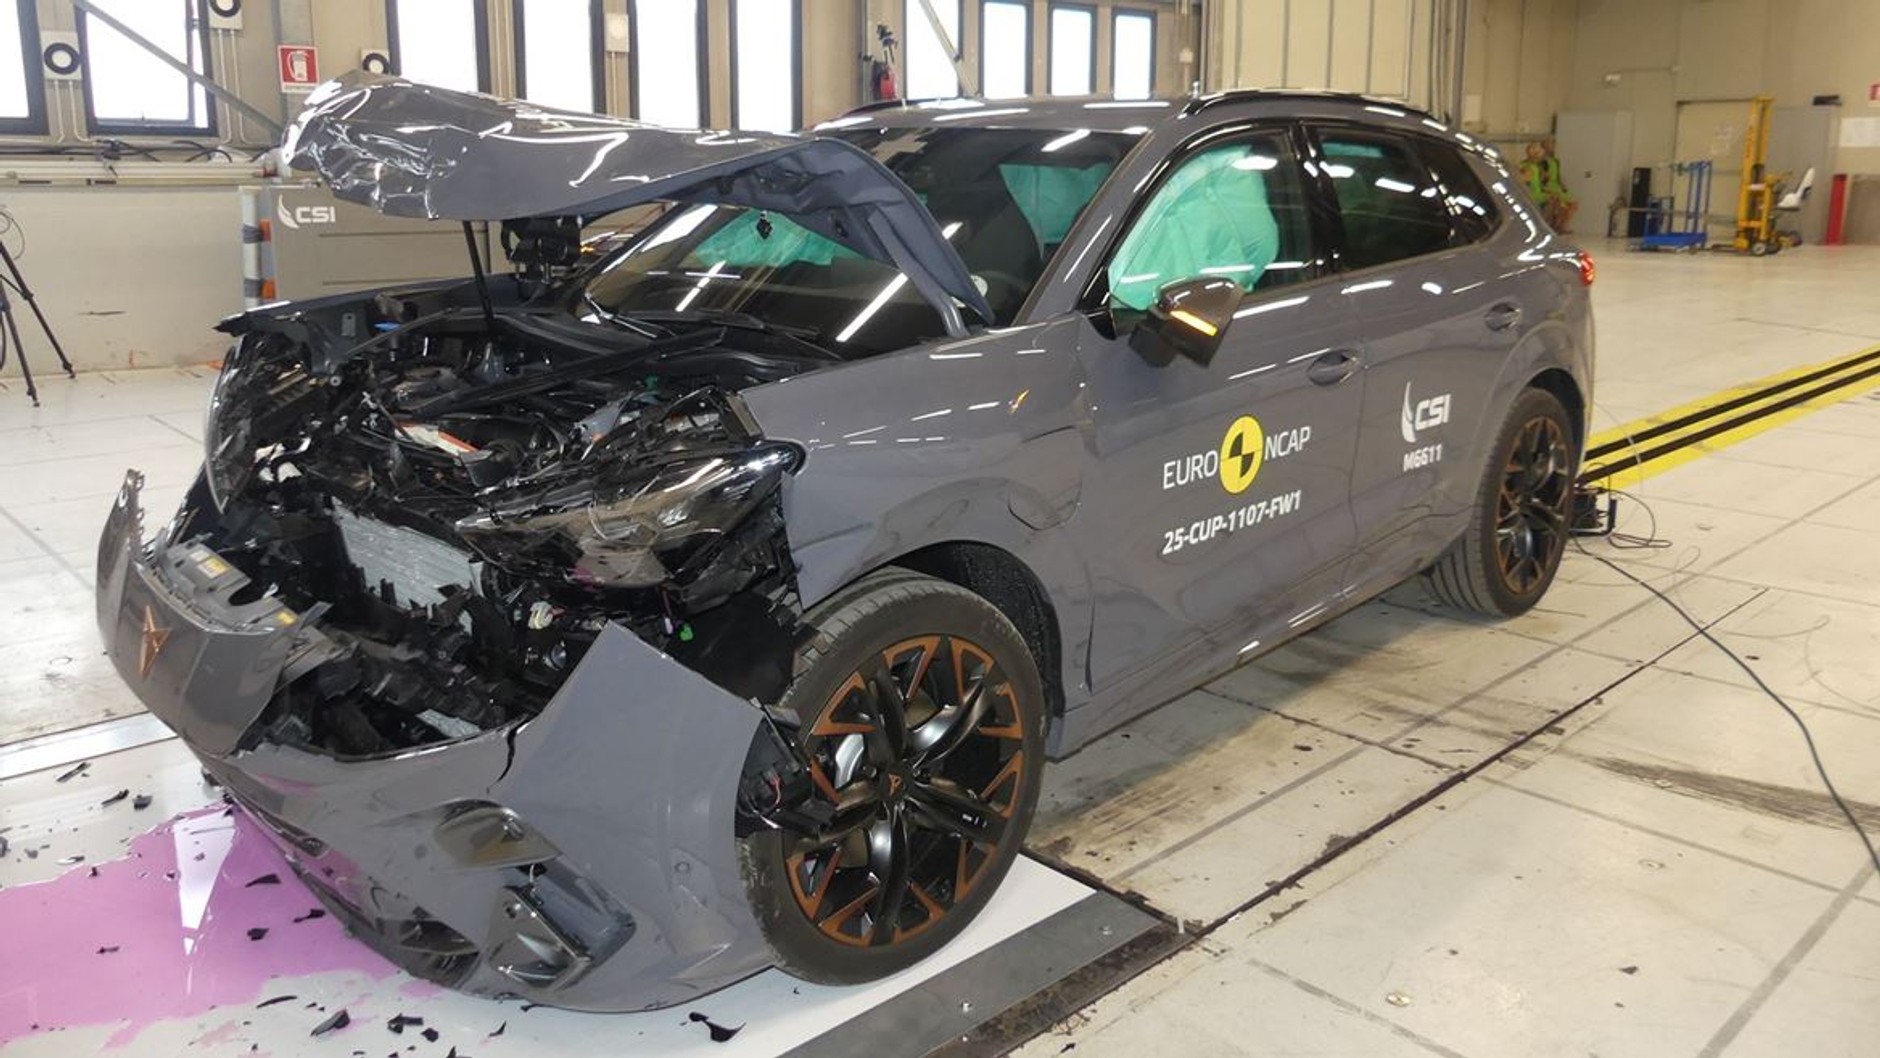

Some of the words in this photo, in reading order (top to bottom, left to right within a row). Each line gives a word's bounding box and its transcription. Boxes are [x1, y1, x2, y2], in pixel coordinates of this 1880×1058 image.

[295, 206, 336, 224] CSI
[1415, 393, 1451, 431] CSI
[1163, 450, 1218, 490] EURO
[1265, 426, 1311, 460] NCAP
[1403, 443, 1442, 472] M6611
[1162, 490, 1301, 555] 25-CUP-1107-FW1
